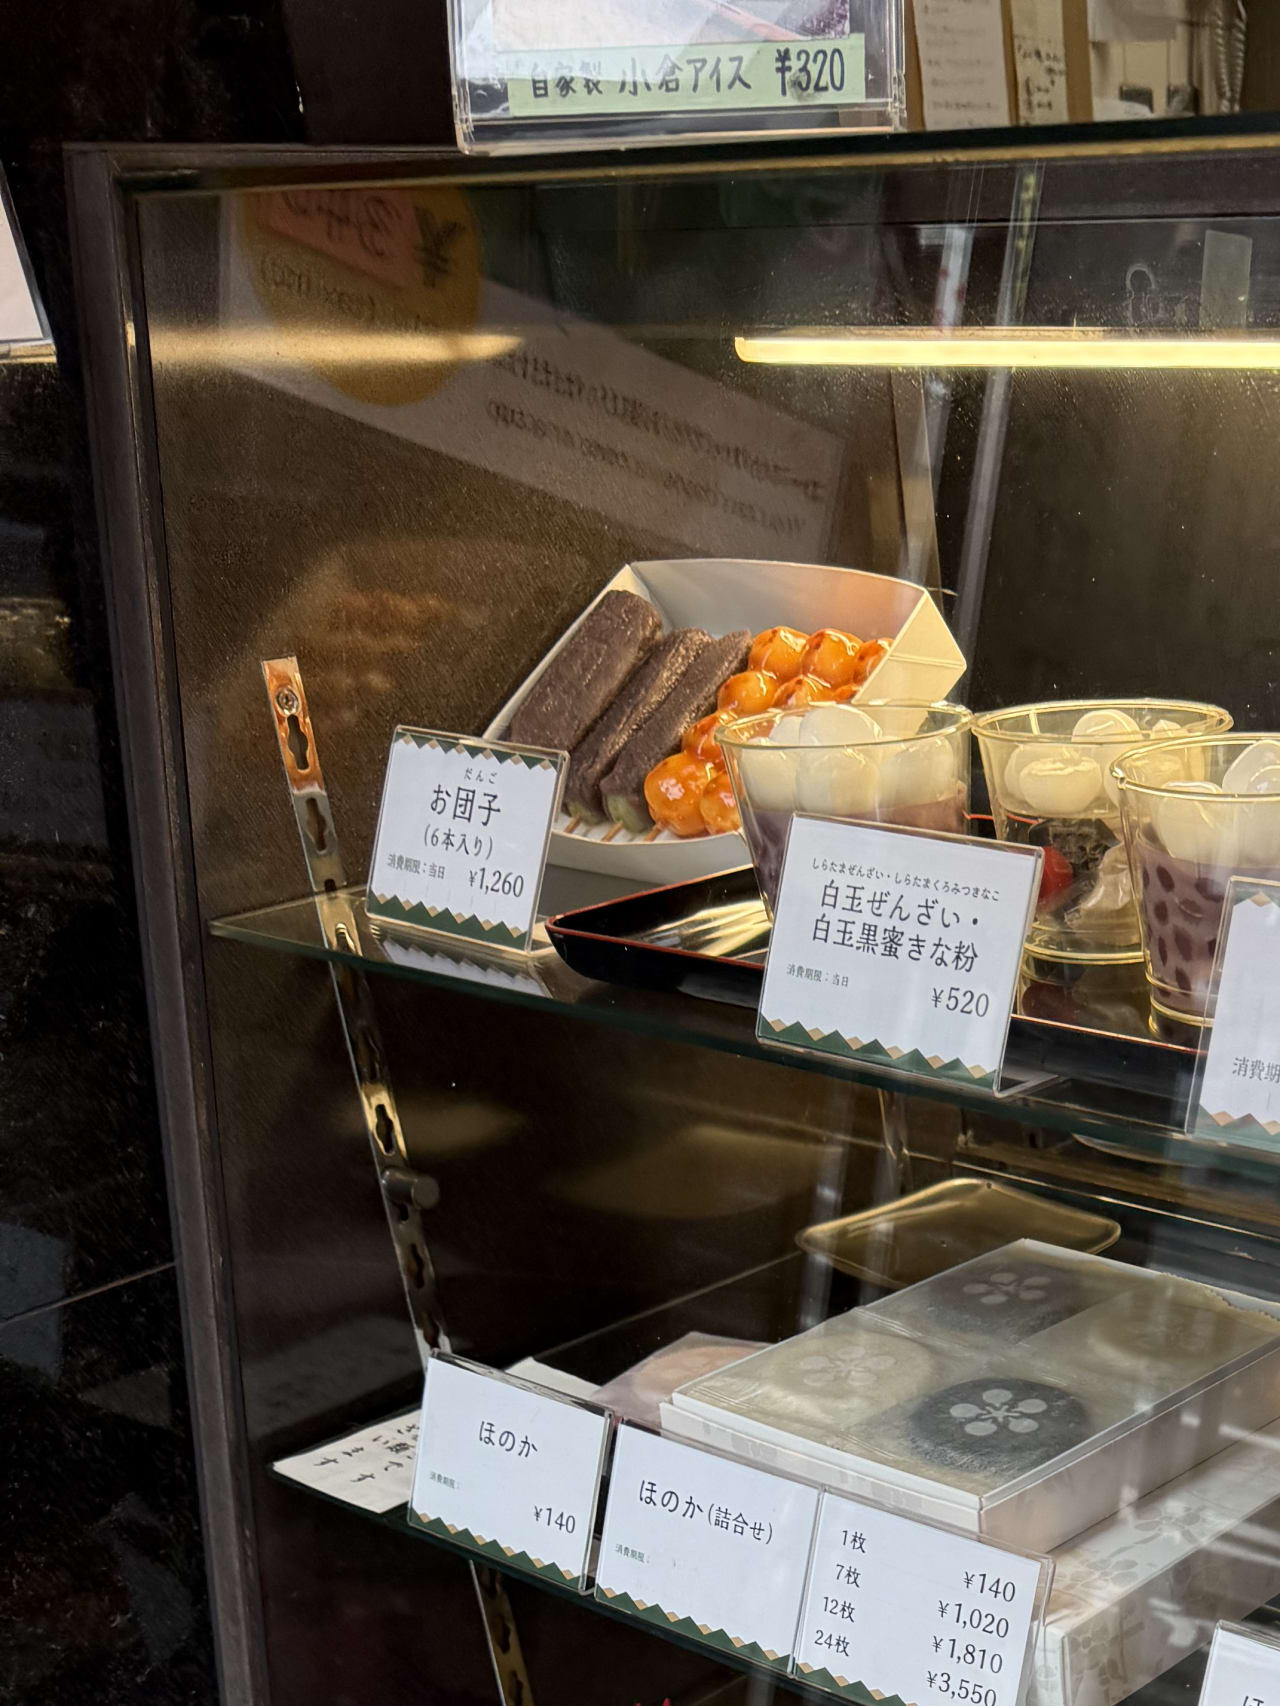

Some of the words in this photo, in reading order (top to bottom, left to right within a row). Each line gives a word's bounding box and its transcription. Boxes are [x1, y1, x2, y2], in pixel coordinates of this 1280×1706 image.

[619, 55, 752, 97] 小倉アイス
[776, 47, 845, 96] ¥320
[430, 784, 501, 826] お団子
[424, 823, 493, 860] (6本入り)
[469, 867, 524, 897] ¥1,260
[812, 913, 978, 973] 白玉黒蜜きな粉
[931, 987, 990, 1017] ¥520
[478, 1420, 538, 1459] ほのか
[534, 1505, 576, 1534] ¥140
[638, 1479, 773, 1545] ほのか(詰合せ)
[841, 1529, 867, 1554] 1枚
[962, 1571, 1017, 1603] ¥140
[835, 1564, 861, 1588] 7枚
[938, 1600, 1009, 1639] ¥1,020
[814, 1630, 851, 1657] 24枚
[823, 1597, 856, 1623] 12枚
[932, 1635, 1003, 1675] ¥1,810
